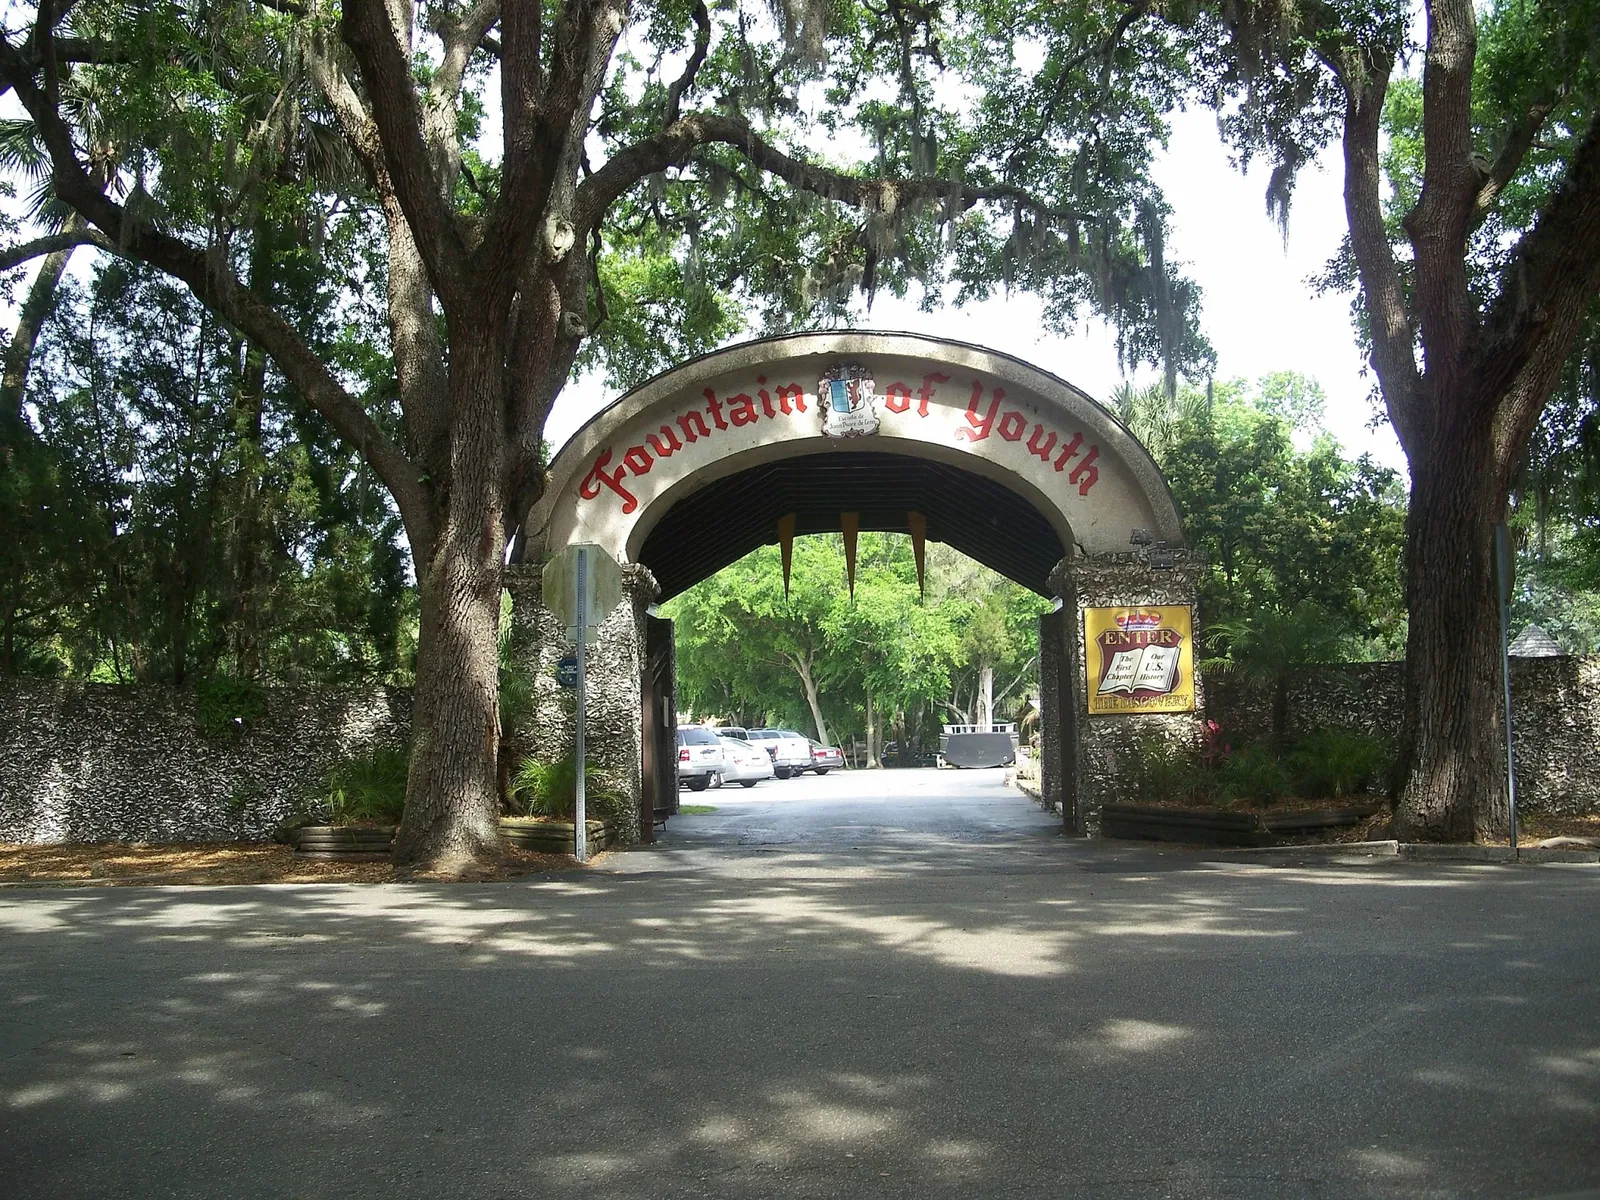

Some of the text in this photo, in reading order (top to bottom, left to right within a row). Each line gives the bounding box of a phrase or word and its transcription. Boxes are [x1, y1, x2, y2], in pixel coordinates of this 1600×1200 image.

[580, 372, 1099, 514] Fountain of Youth
[1105, 630, 1173, 645] ENTER
[1145, 662, 1164, 671] U.S.
[1106, 673, 1133, 681] Chapter
[1140, 673, 1165, 681] History
[1095, 694, 1189, 709] THE DISCOVERY
